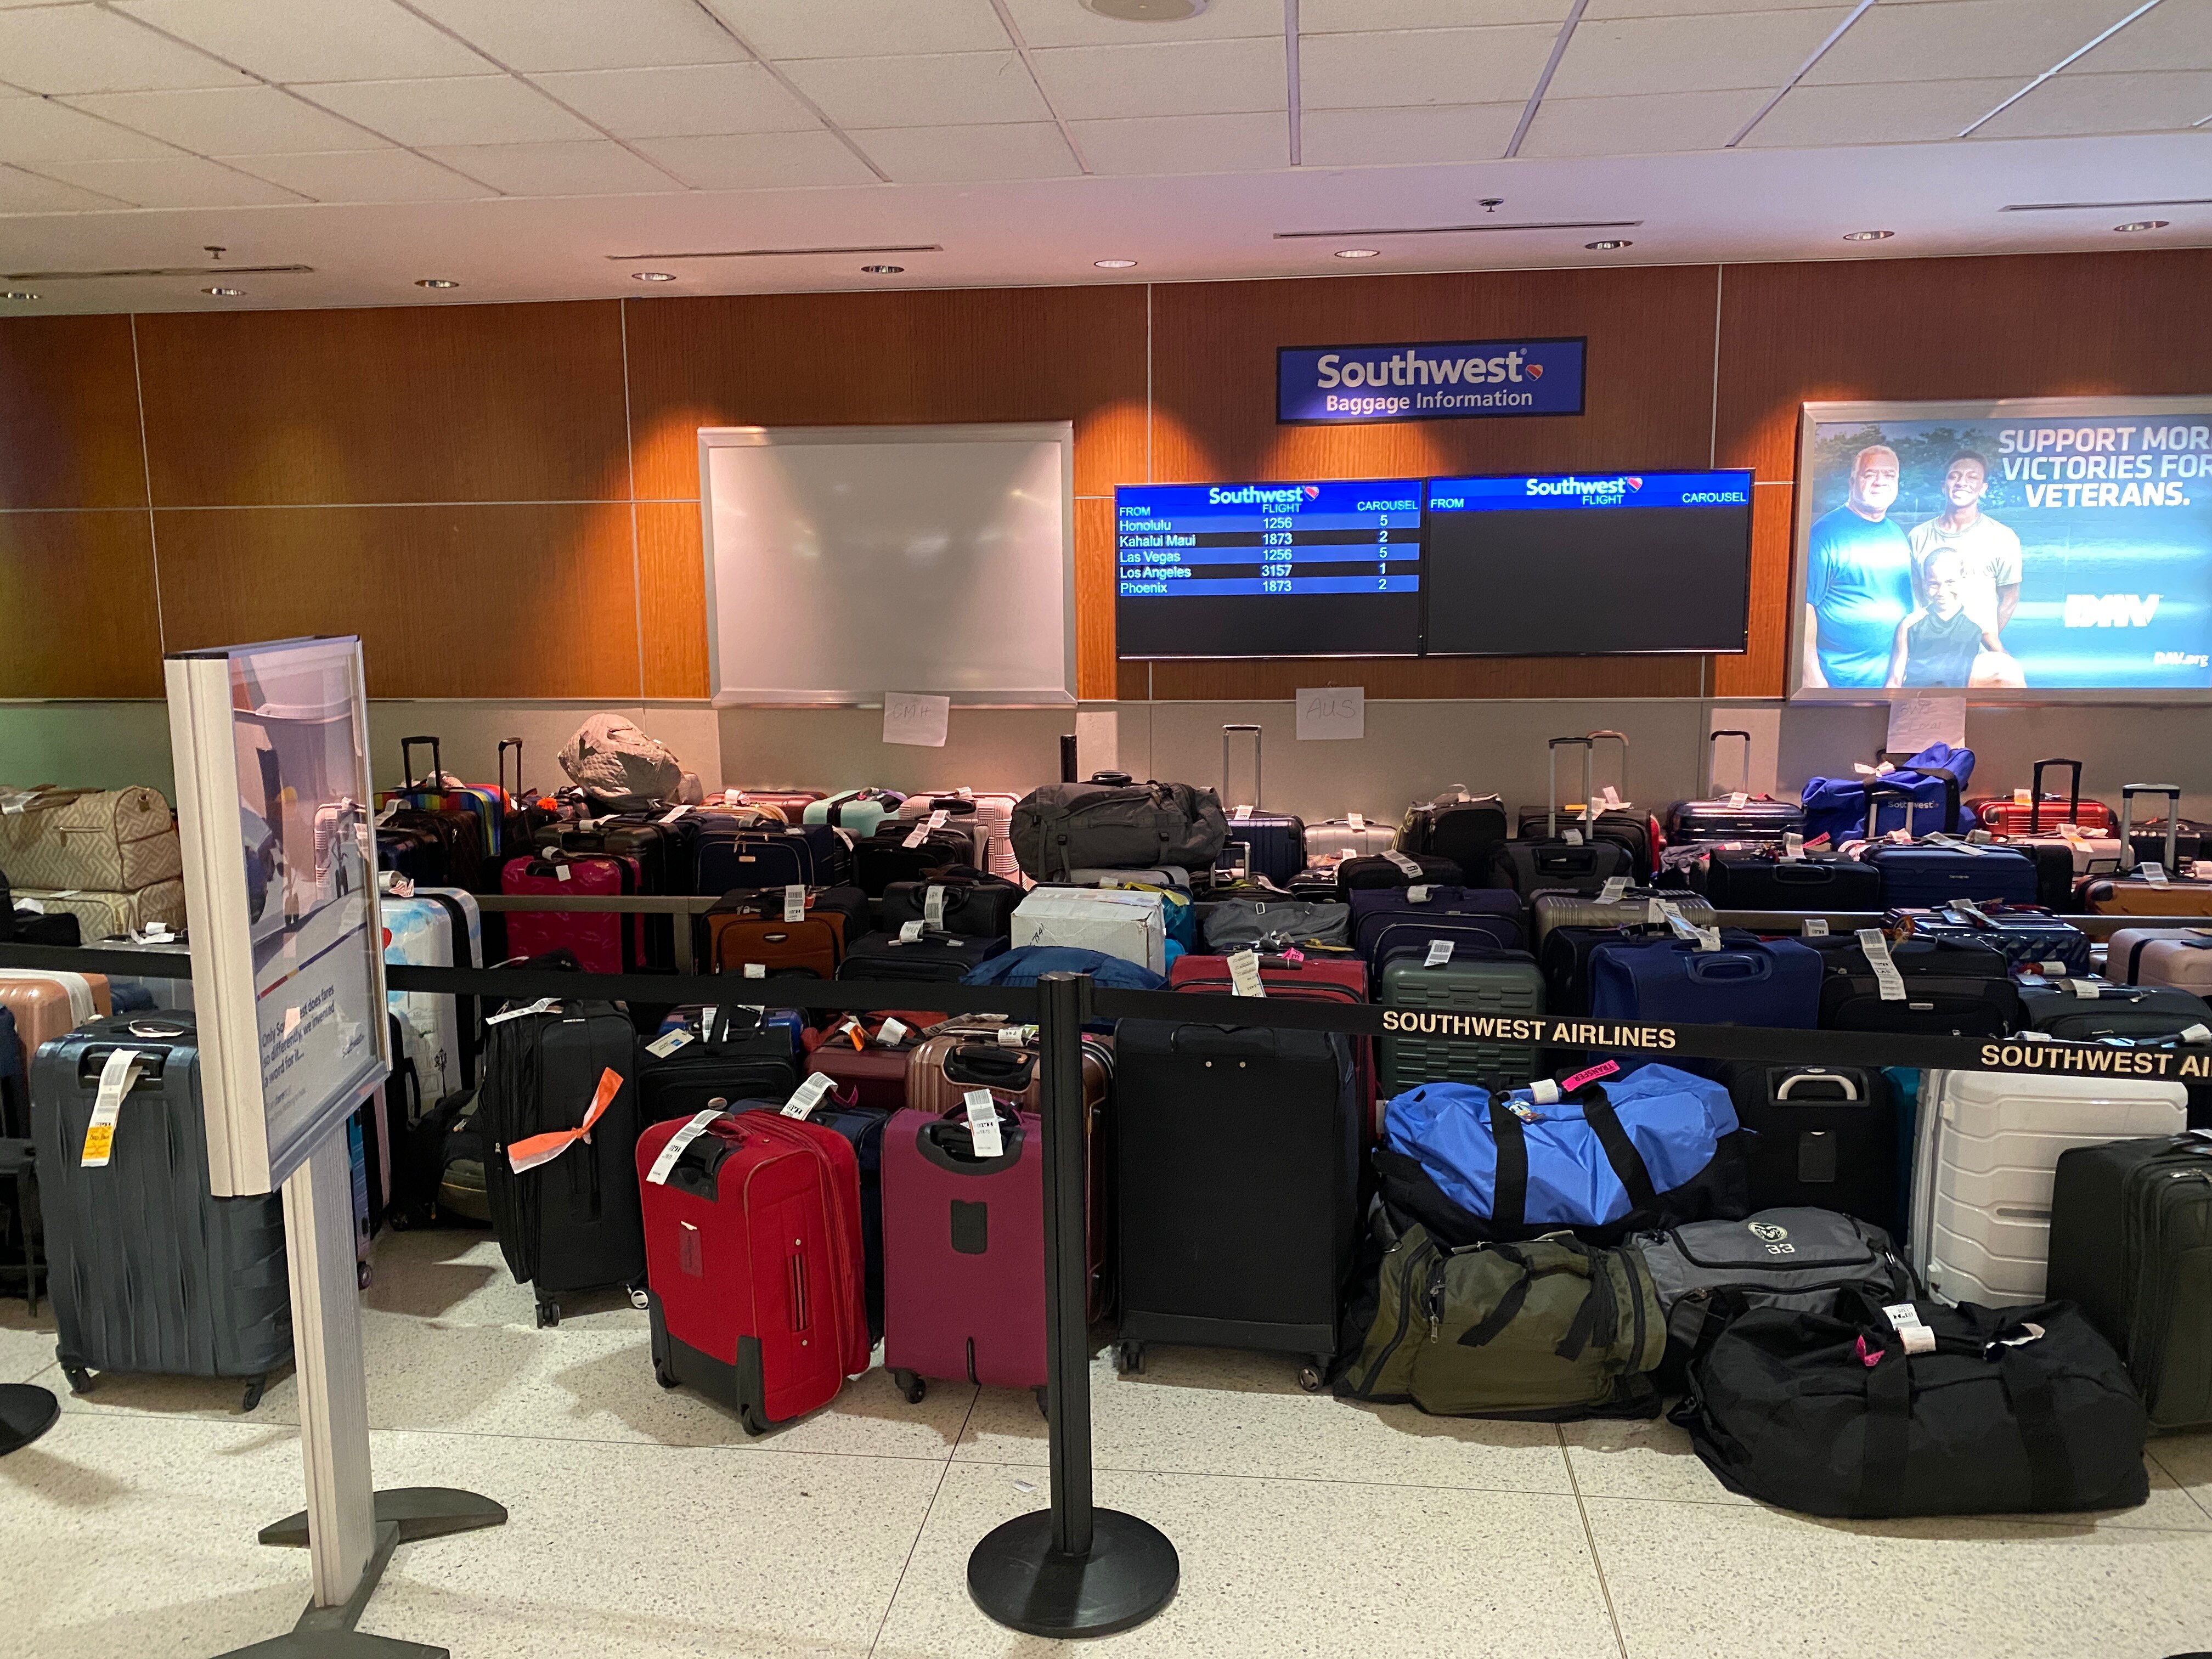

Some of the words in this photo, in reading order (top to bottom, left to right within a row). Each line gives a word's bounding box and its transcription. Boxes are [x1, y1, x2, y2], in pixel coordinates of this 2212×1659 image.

[1317, 350, 1523, 388] Southwest
[1327, 394, 1410, 415] Baggage
[1417, 389, 1533, 409] Information
[1998, 427, 2136, 454] SUPPORT
[2142, 426, 2212, 450] MOR
[2002, 454, 2153, 481] VICTORIES
[2160, 453, 2212, 478] FOR
[1209, 486, 1304, 504] Southwest
[1526, 477, 1626, 496] Southwest
[2024, 481, 2191, 508] VETERANS.
[1120, 506, 1150, 516] FROM
[1262, 503, 1301, 513] FLIGHT
[1357, 500, 1419, 511] CAROUSEL
[1430, 498, 1464, 509] FROM
[1582, 494, 1624, 506] FLIGHT
[1682, 492, 1747, 504] CAROUSEL
[1120, 519, 1171, 532] Honolulu
[1263, 516, 1293, 529] 1256
[1379, 514, 1389, 527] 5
[1120, 535, 1164, 548] Kahalui
[1166, 534, 1197, 546] Maui
[1262, 532, 1293, 545] 1873
[1379, 531, 1389, 543] 2
[1120, 551, 1141, 563] Las
[1143, 551, 1181, 565] Vegas
[1263, 548, 1293, 561] 1256
[1379, 546, 1387, 558] 5
[1120, 567, 1142, 579] Los
[1143, 566, 1192, 580] Angeles
[1261, 564, 1293, 577] 3157
[1379, 562, 1386, 574] 1
[1120, 582, 1168, 594] Phoenix
[1262, 579, 1292, 592] 1873
[1378, 578, 1387, 590] 2
[1306, 697, 1356, 719] AUS
[262, 1029, 276, 1047] Only
[276, 1007, 307, 1032] Soest
[308, 996, 321, 1012] does
[321, 985, 334, 1002] fares
[1383, 1011, 1546, 1041] SOUTHWEST
[1552, 1022, 1676, 1049] AIRLINES
[263, 1057, 270, 1068] so
[302, 1022, 312, 1035] we
[1981, 1045, 2174, 1075] SOUTHWEST
[2179, 1055, 2212, 1077] AI
[264, 1077, 269, 1088] a
[269, 1062, 285, 1083] word
[285, 1057, 295, 1069] for
[1573, 1063, 1615, 1082] TRANSFER
[1765, 1243, 1796, 1255] 33
